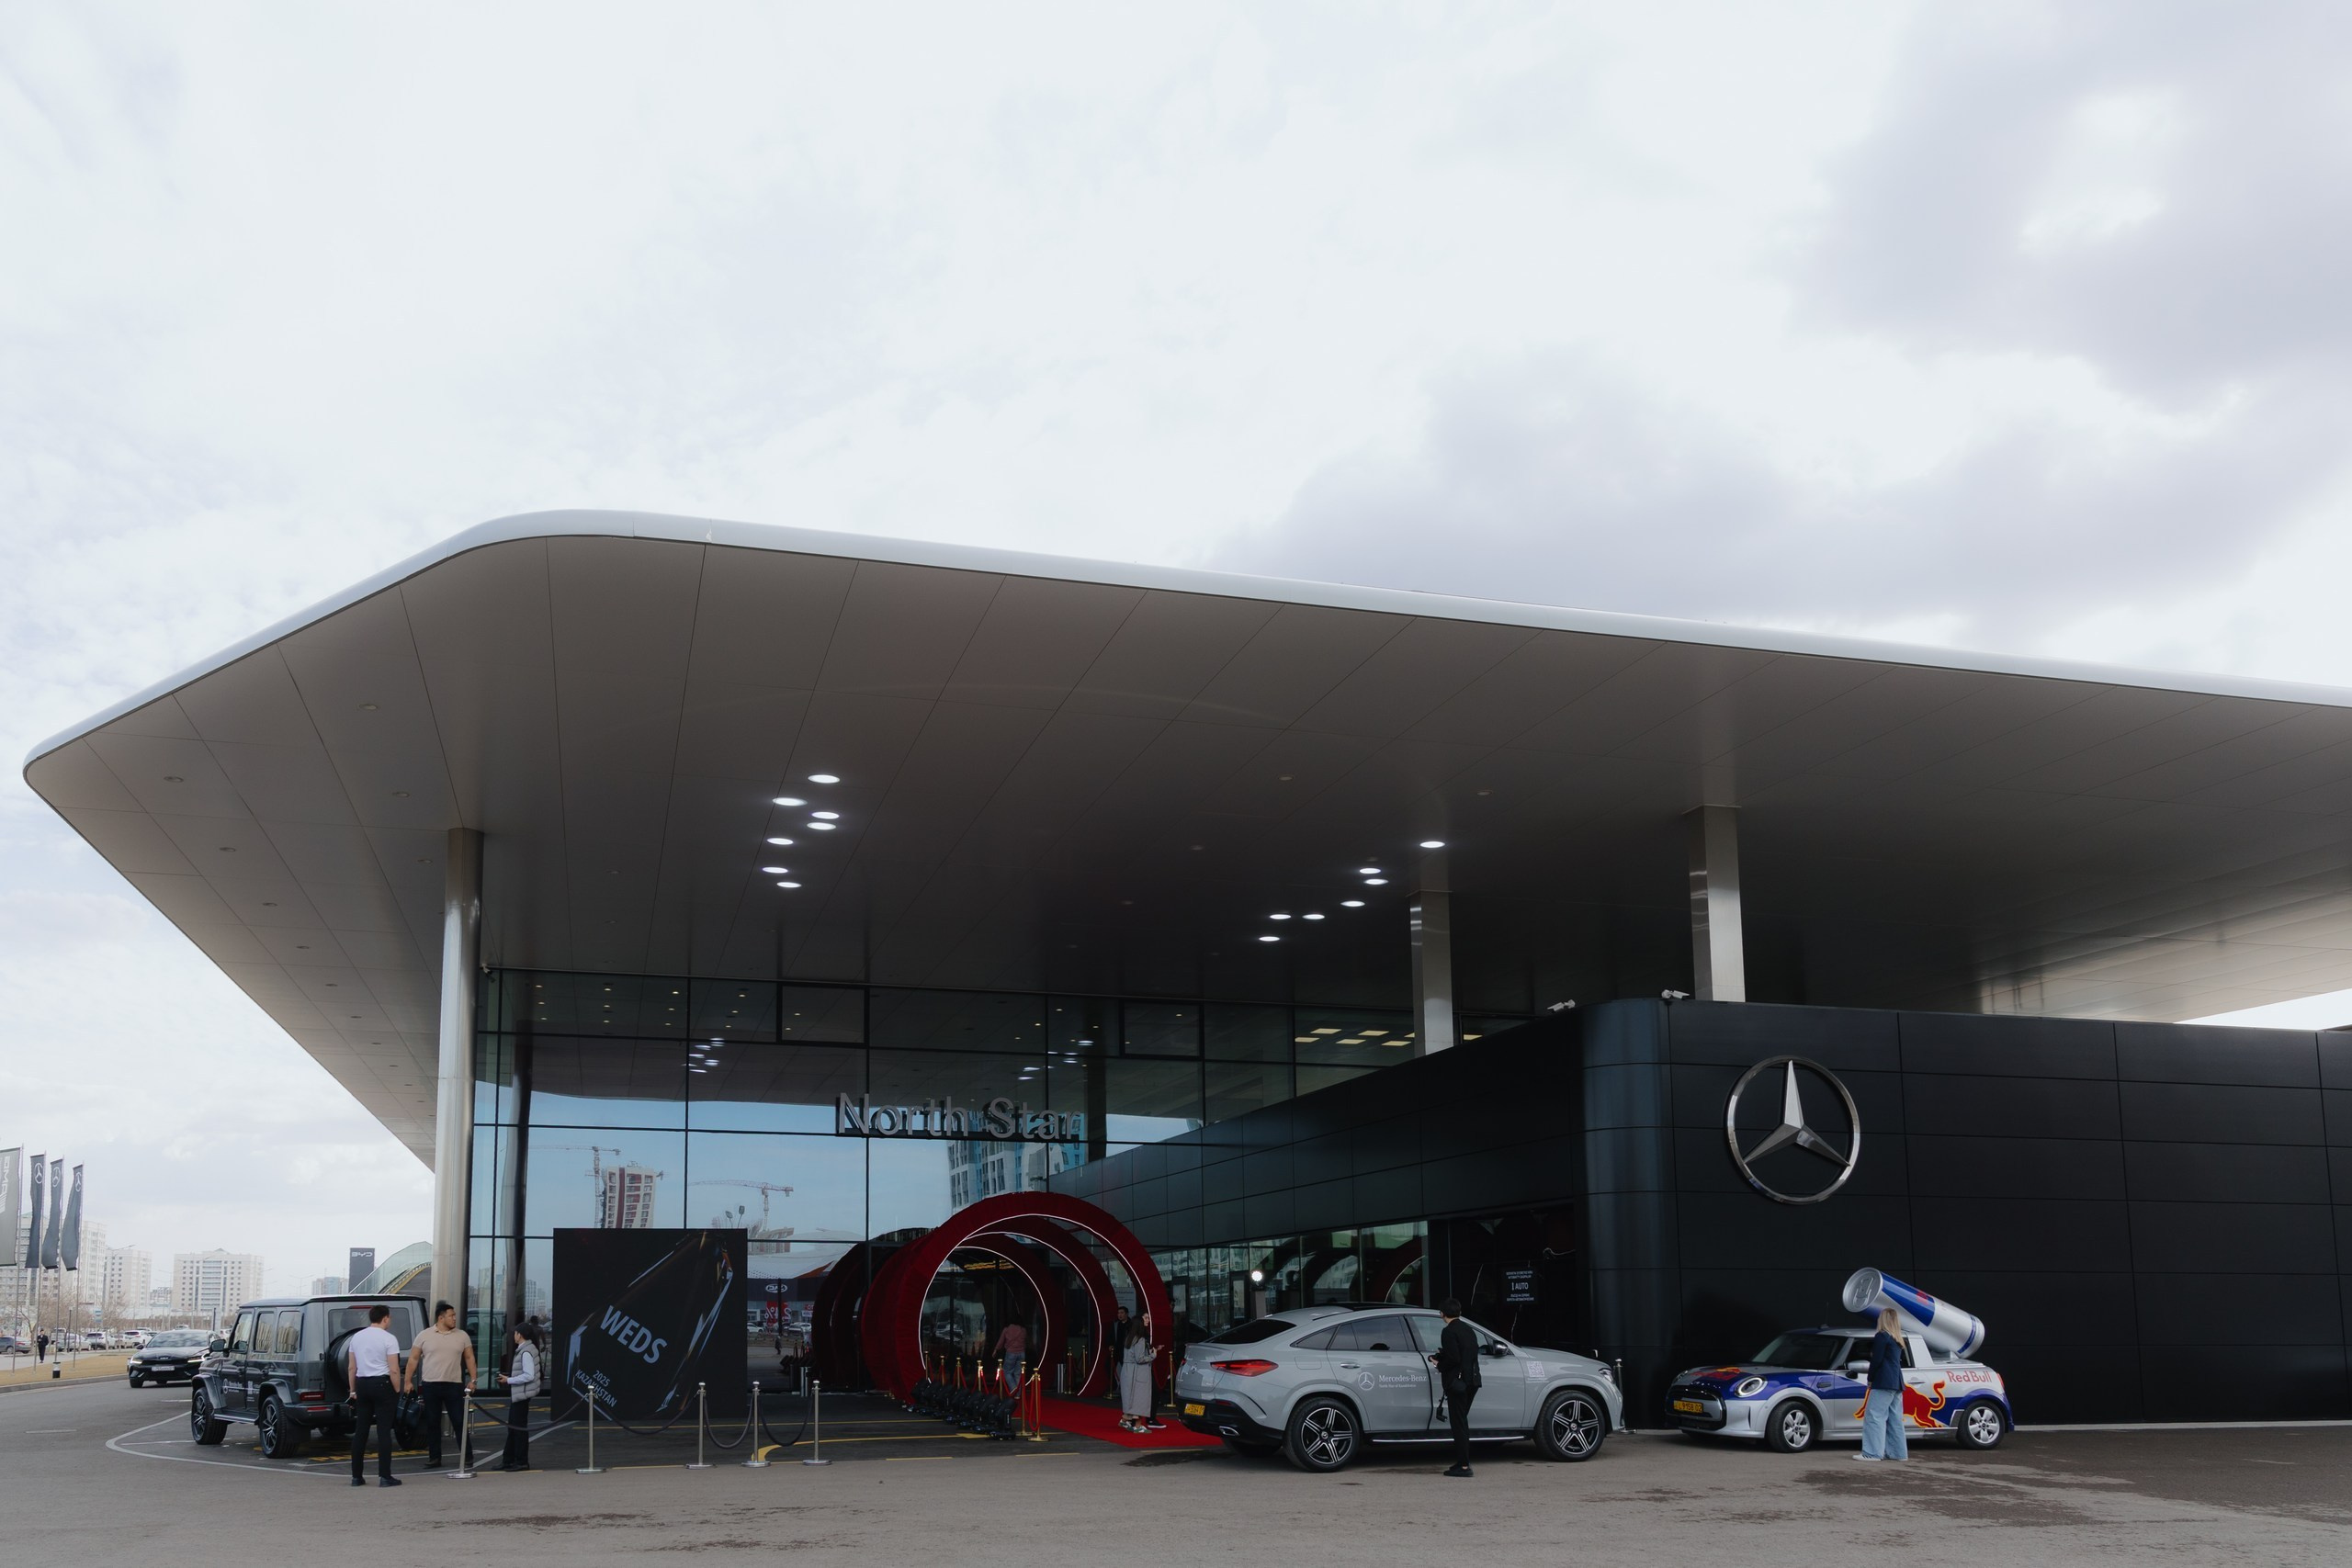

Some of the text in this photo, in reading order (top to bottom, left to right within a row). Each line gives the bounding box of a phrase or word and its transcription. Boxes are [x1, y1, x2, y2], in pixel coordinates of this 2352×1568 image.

[837, 1091, 1082, 1140] North Star
[599, 1304, 668, 1364] WEDS
[593, 1370, 611, 1387] 2025
[1379, 1374, 1427, 1382] Mercedes-Benz
[1946, 1371, 1992, 1383] Red Bull
